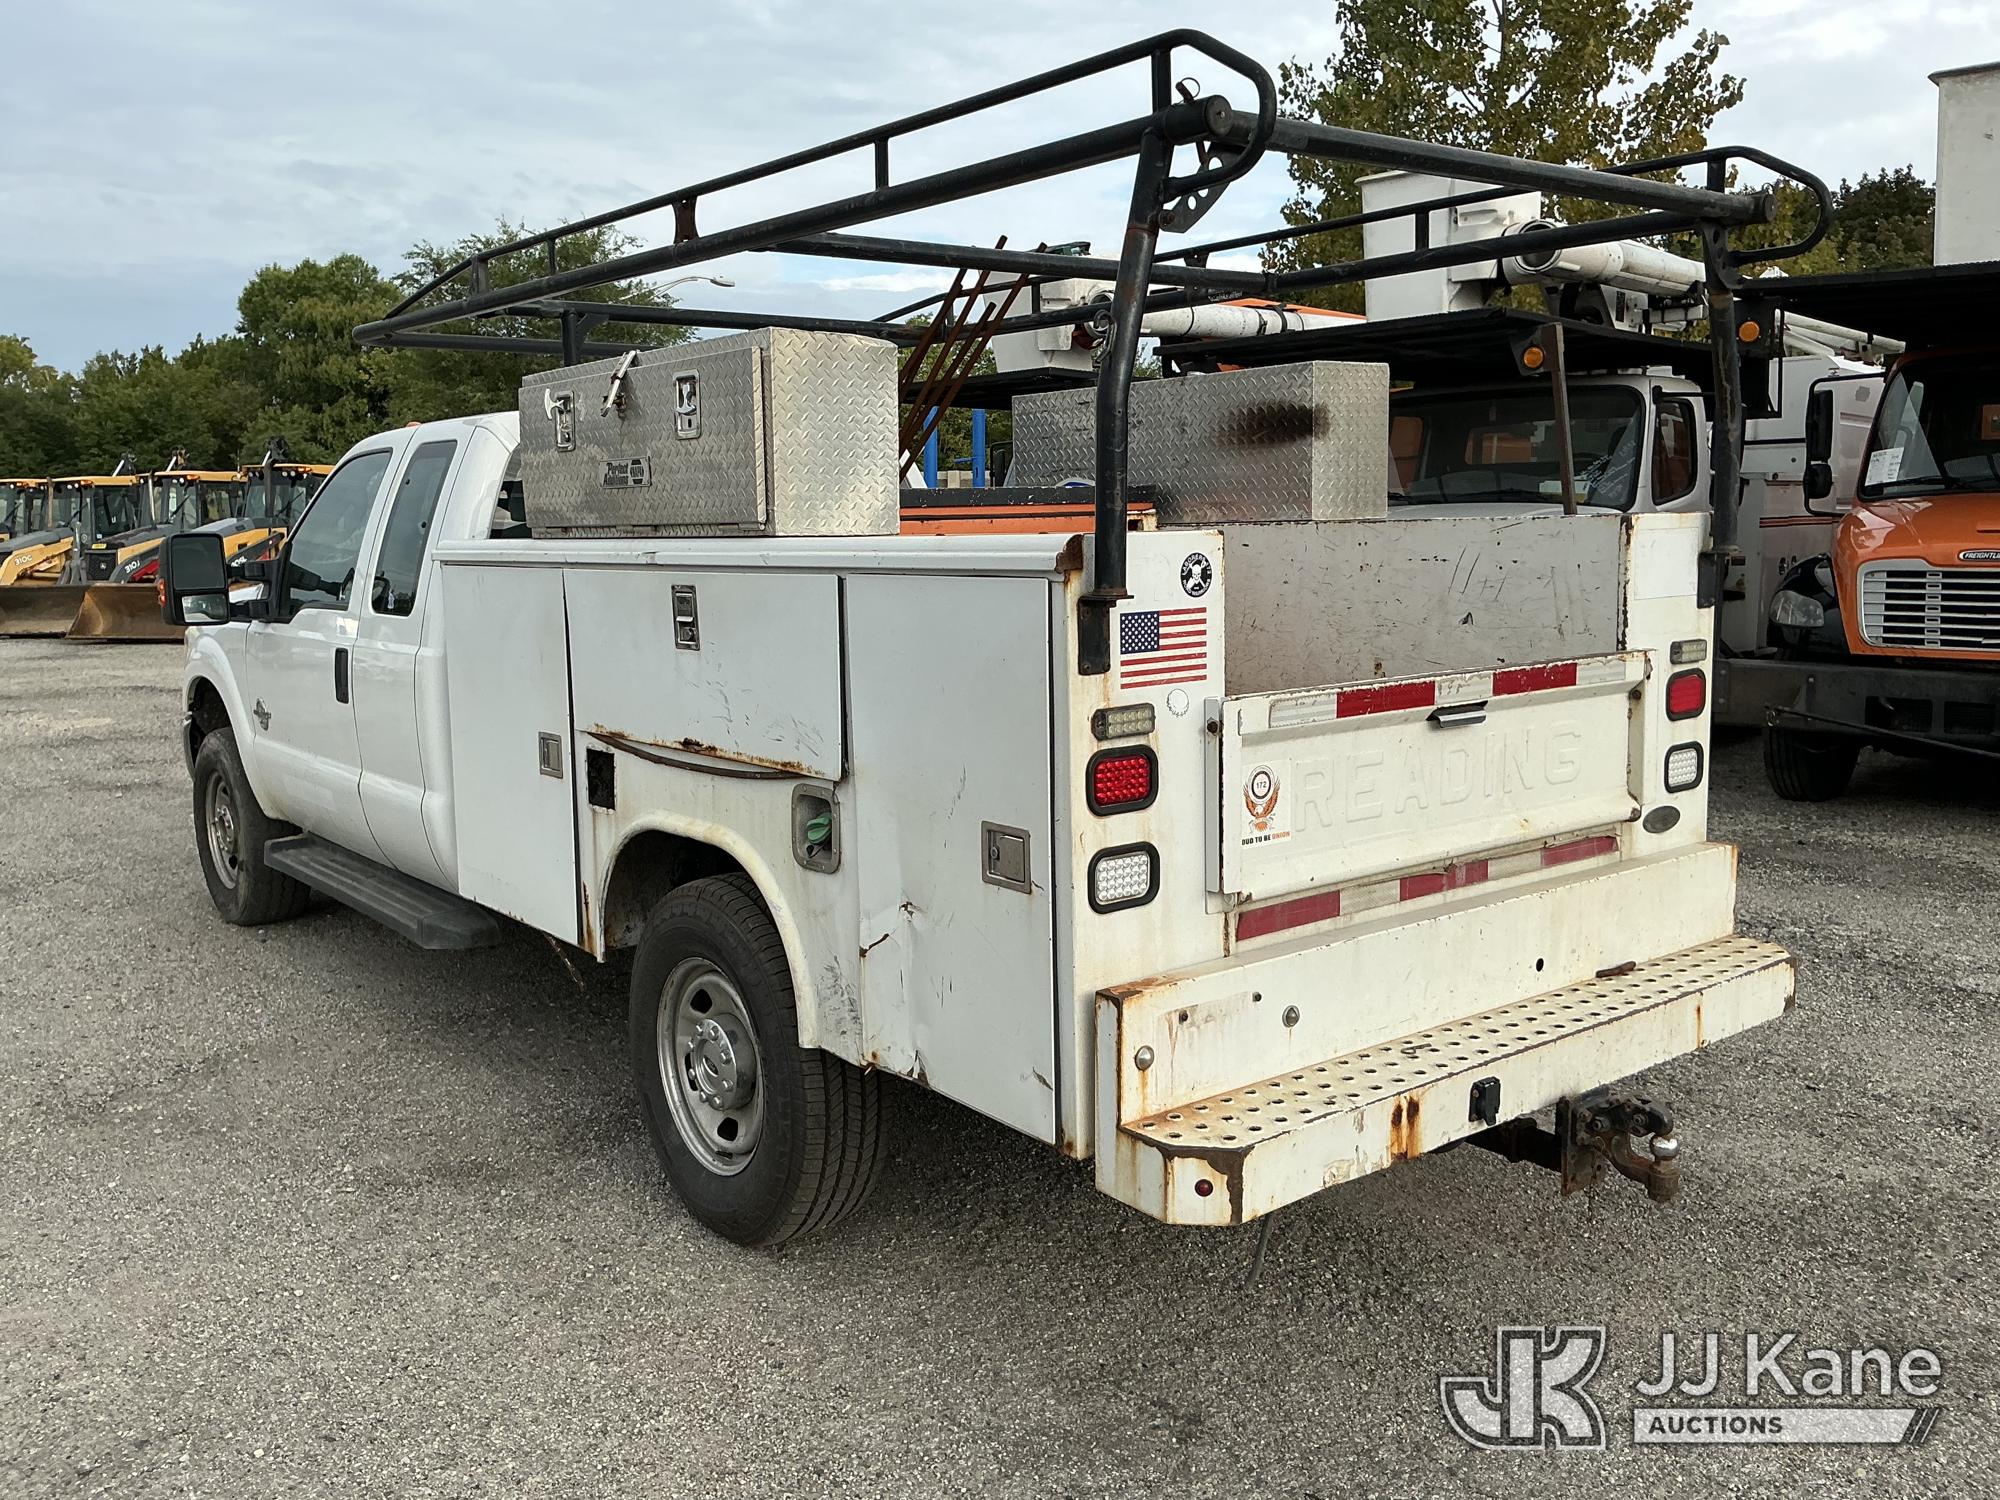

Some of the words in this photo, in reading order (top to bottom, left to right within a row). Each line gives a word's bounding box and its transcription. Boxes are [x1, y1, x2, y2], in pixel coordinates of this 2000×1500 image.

[1290, 720, 1583, 833] READING
[1256, 781, 1267, 789] 172
[1255, 835, 1263, 843] TO
[1263, 833, 1272, 841] BE
